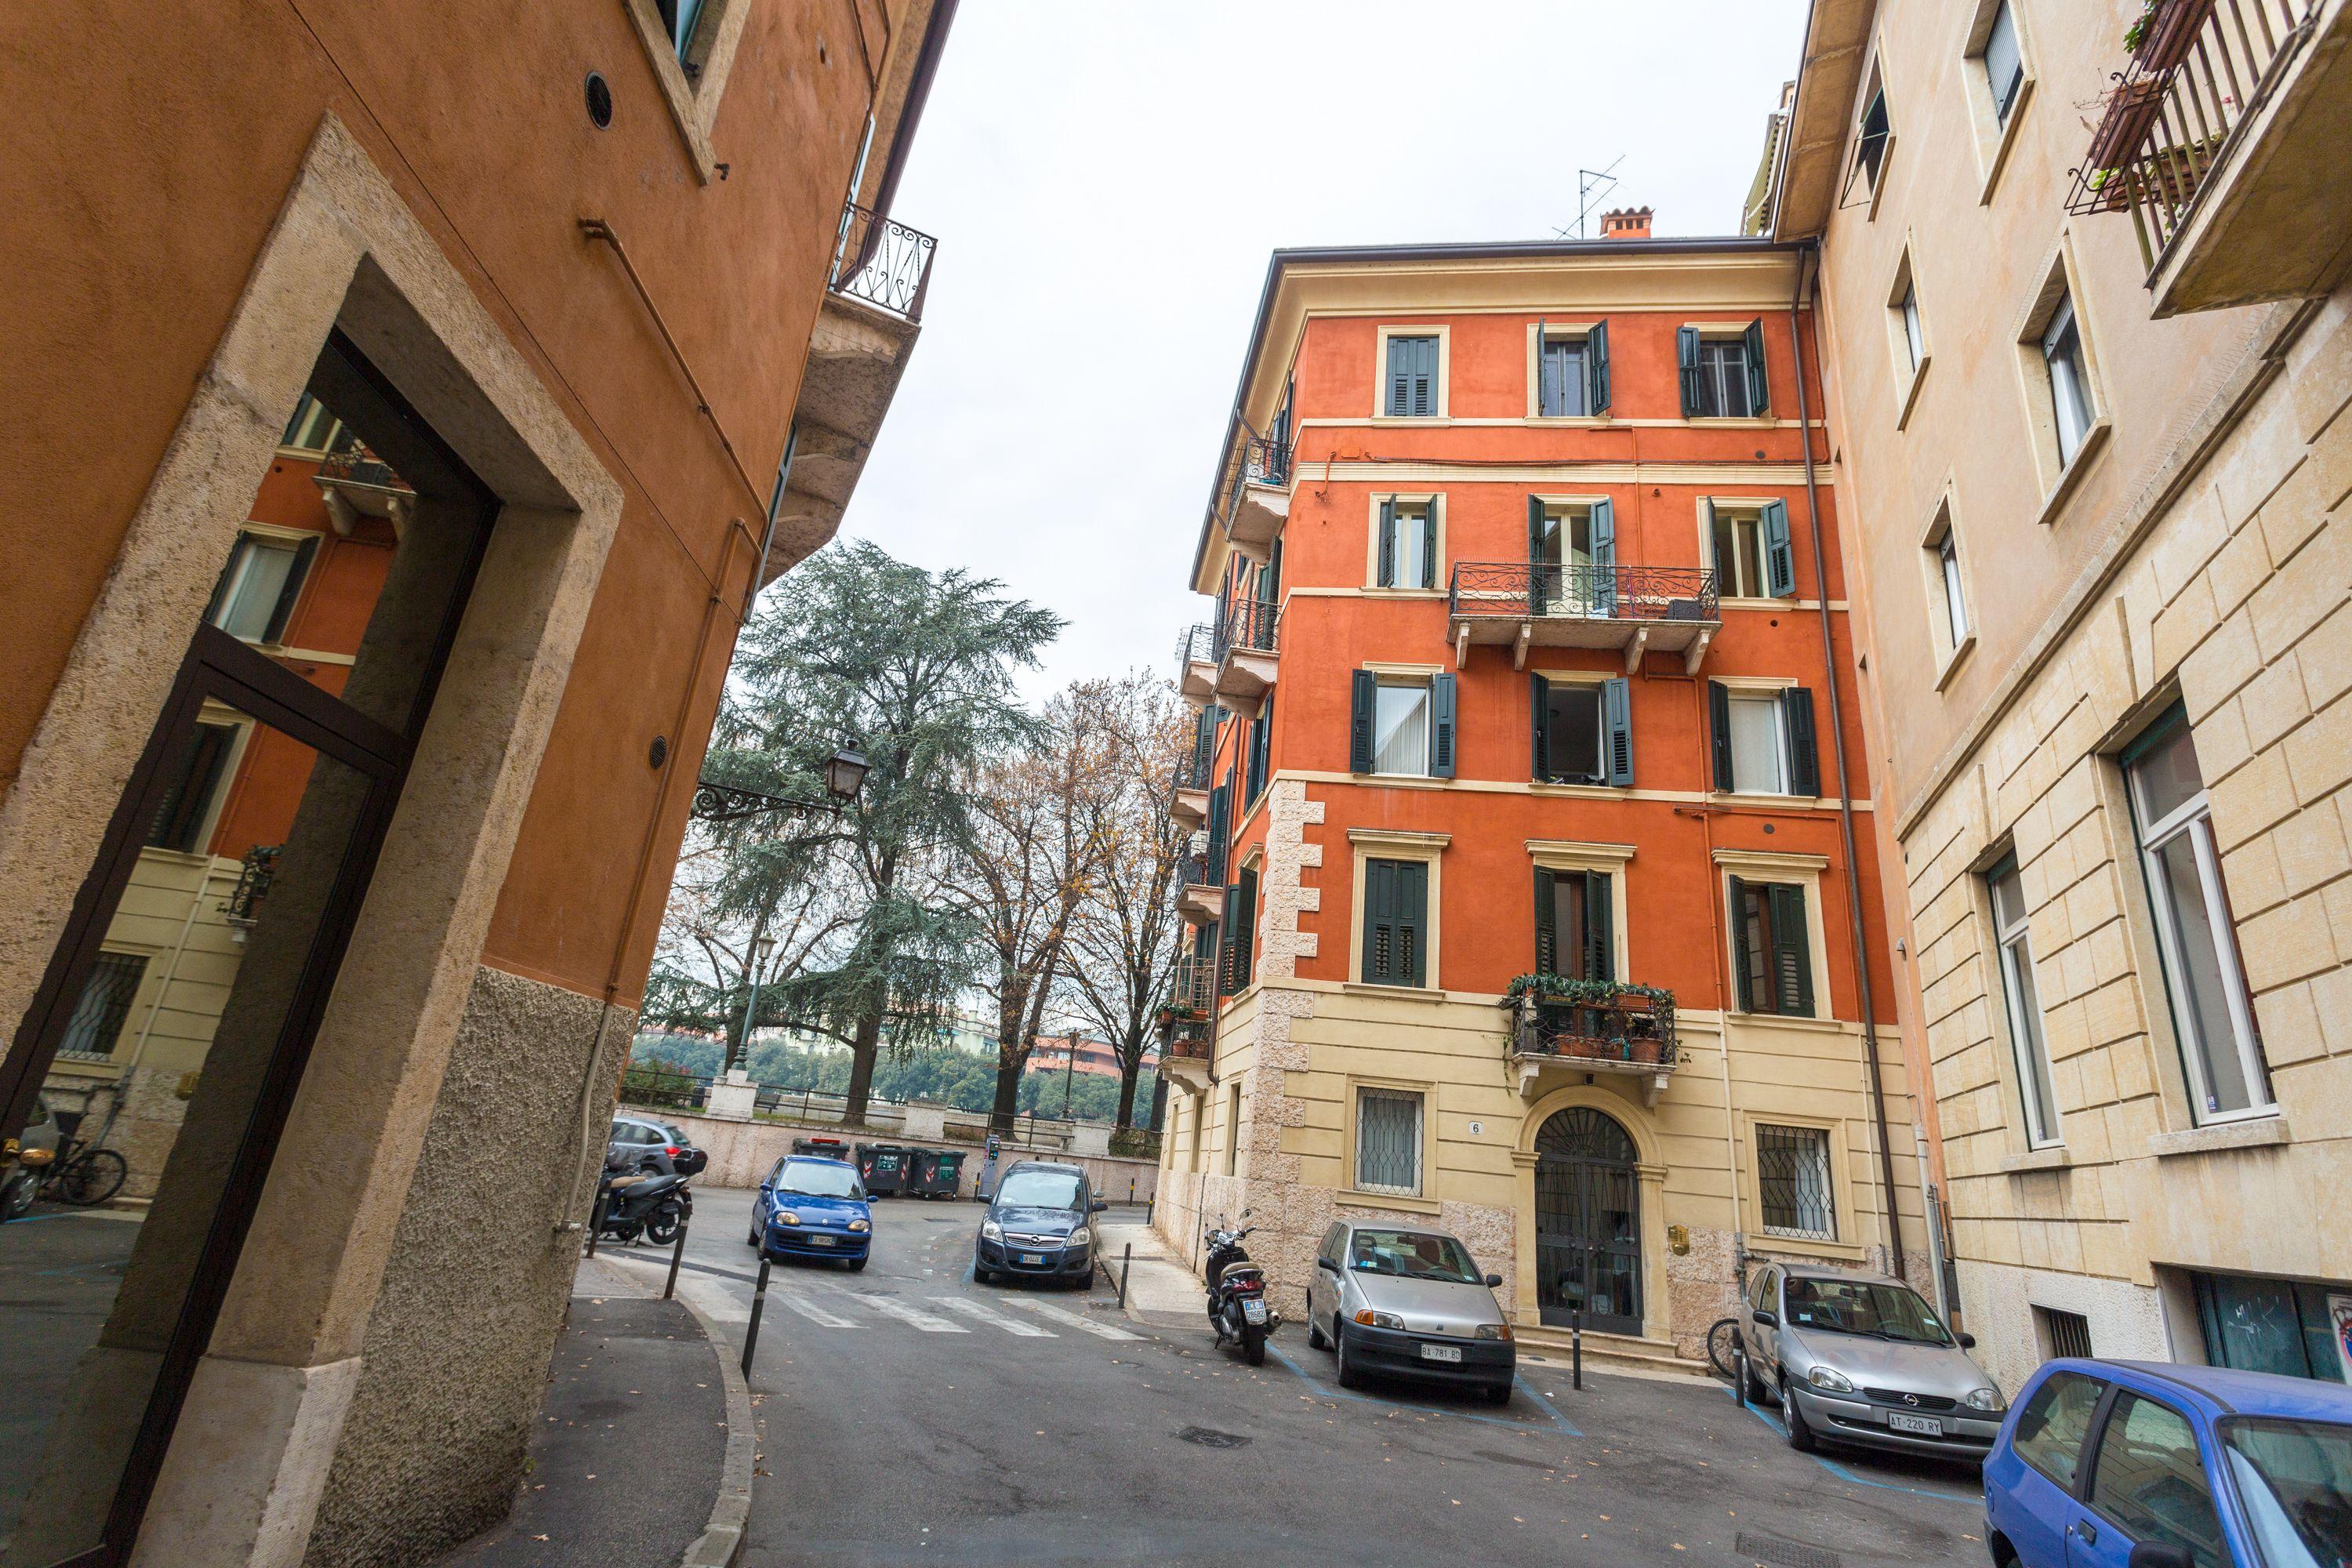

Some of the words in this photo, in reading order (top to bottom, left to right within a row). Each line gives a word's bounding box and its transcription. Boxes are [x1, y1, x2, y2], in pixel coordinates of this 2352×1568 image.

[1473, 1123, 1479, 1133] 6
[1423, 1347, 1431, 1356] BA
[1436, 1348, 1447, 1357] 781
[1891, 1417, 1901, 1426] AT
[1907, 1418, 1924, 1429] 220
[1928, 1421, 1939, 1432] RY
